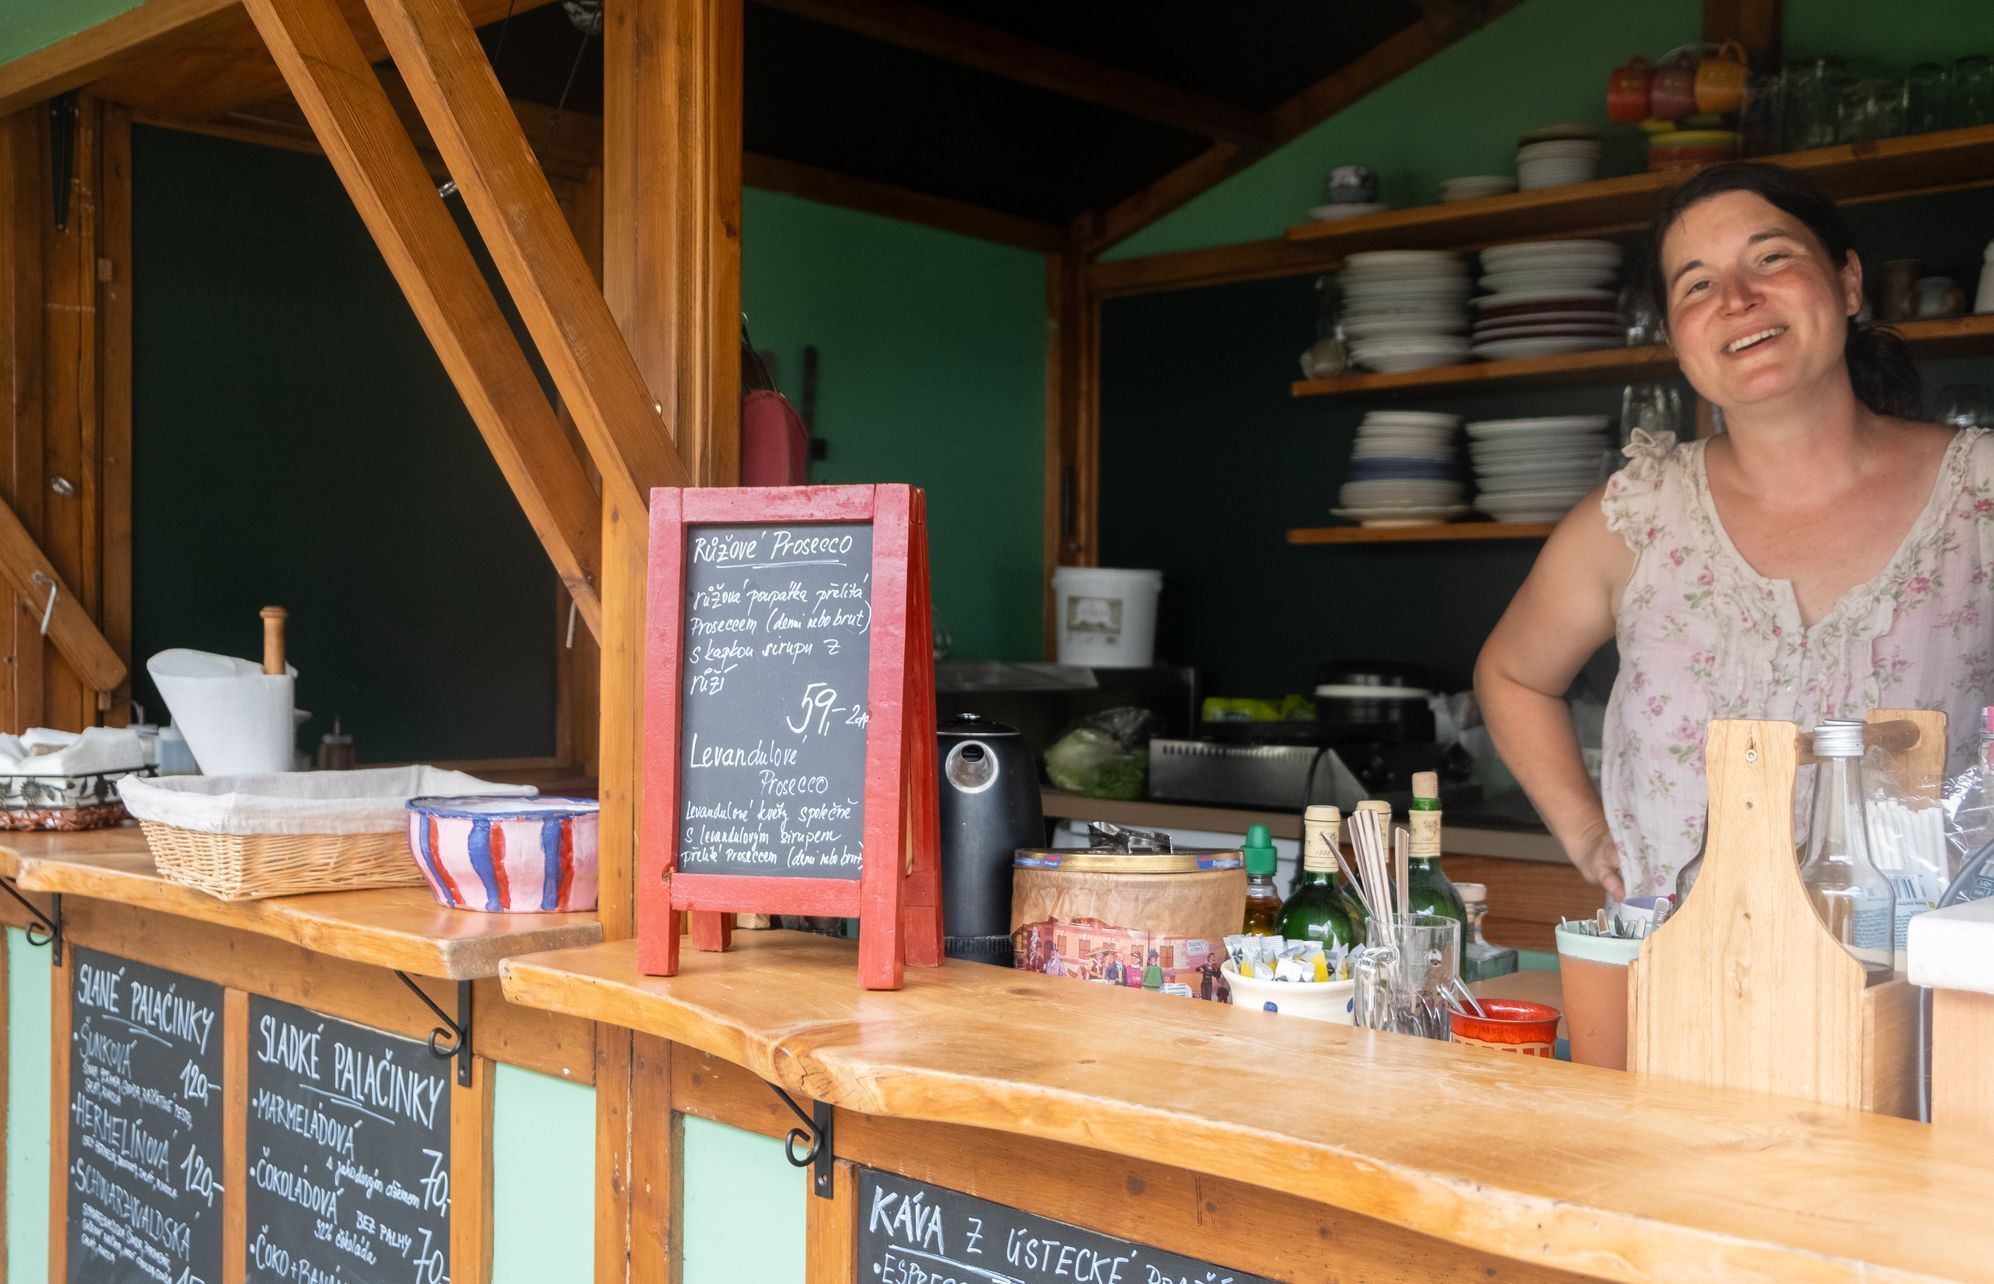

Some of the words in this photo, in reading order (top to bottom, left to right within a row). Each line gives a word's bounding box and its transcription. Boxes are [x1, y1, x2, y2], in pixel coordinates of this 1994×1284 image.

[694, 531, 766, 563] Růžové
[771, 531, 853, 560] Prosecco
[690, 617, 757, 636] Proseccem
[758, 769, 829, 796] Prosecco
[78, 963, 126, 1014] SLANÉ
[130, 982, 215, 1056] PALAČINKY
[257, 1014, 325, 1081] SLADKÉ
[334, 1041, 445, 1130] PALAČINKY
[257, 1087, 363, 1161] MARMELÁDOVÁ
[255, 1146, 345, 1226] ČOKOLÁDOVÁ
[413, 1227, 450, 1284] 70-
[869, 1185, 944, 1256] KÁVA
[1006, 1228, 1137, 1284] ÚSTECKÉ
